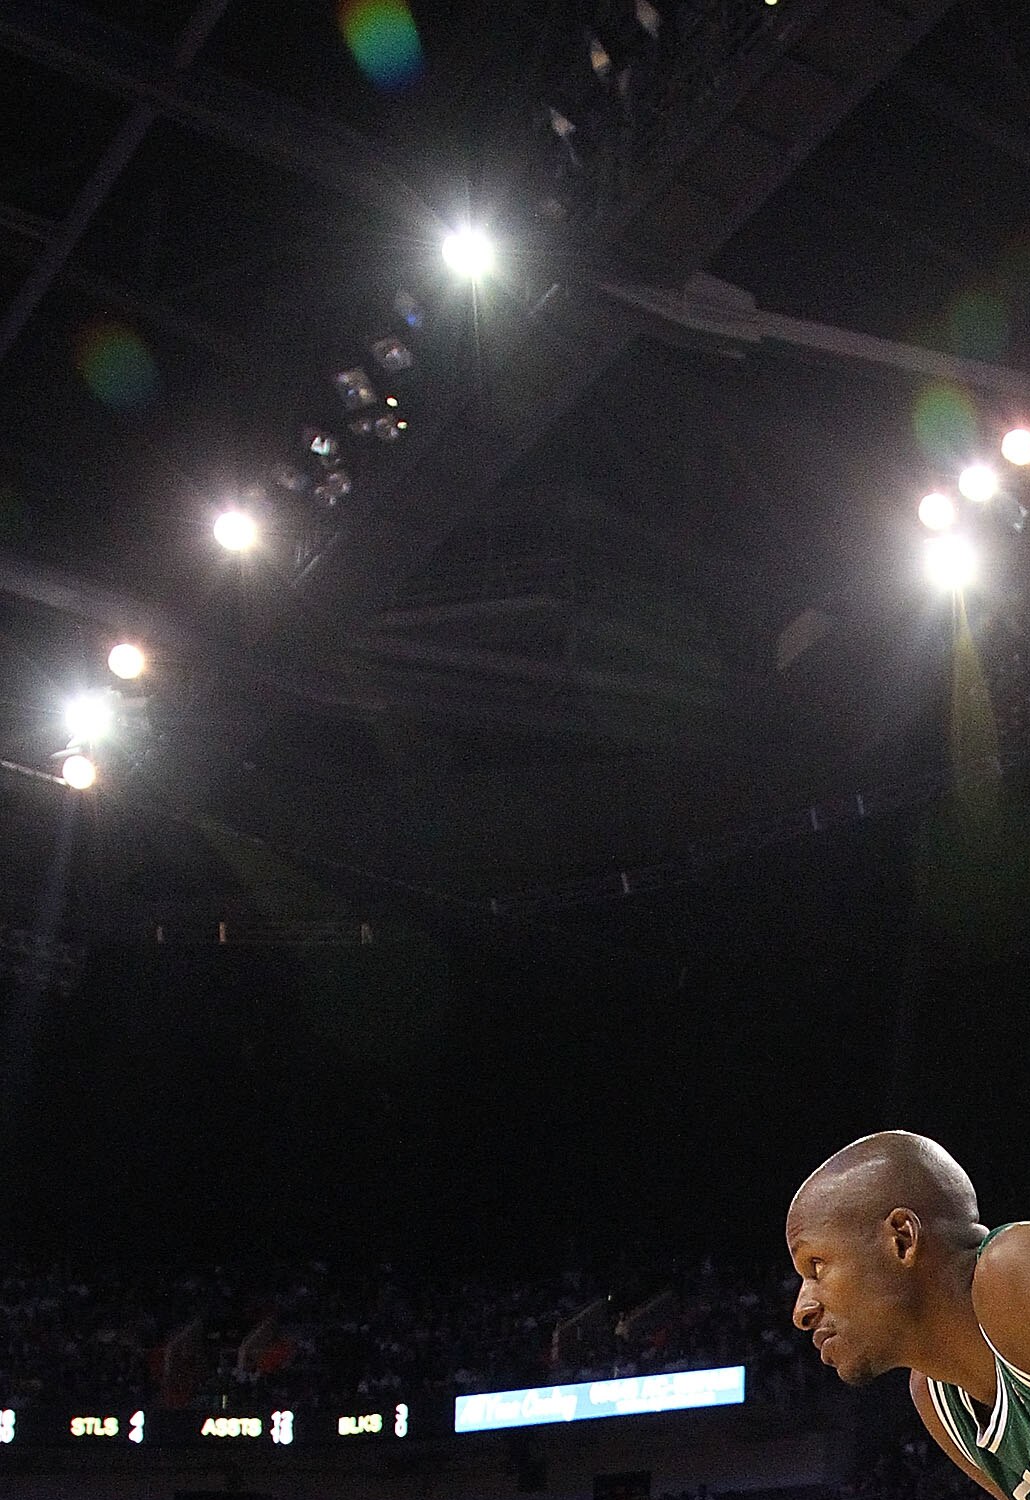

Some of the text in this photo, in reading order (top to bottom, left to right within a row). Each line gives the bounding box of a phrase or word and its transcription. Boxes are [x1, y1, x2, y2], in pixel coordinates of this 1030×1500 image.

[70, 1416, 119, 1437] STLS
[201, 1417, 263, 1437] ASSTS
[338, 1413, 383, 1435] BLKS
